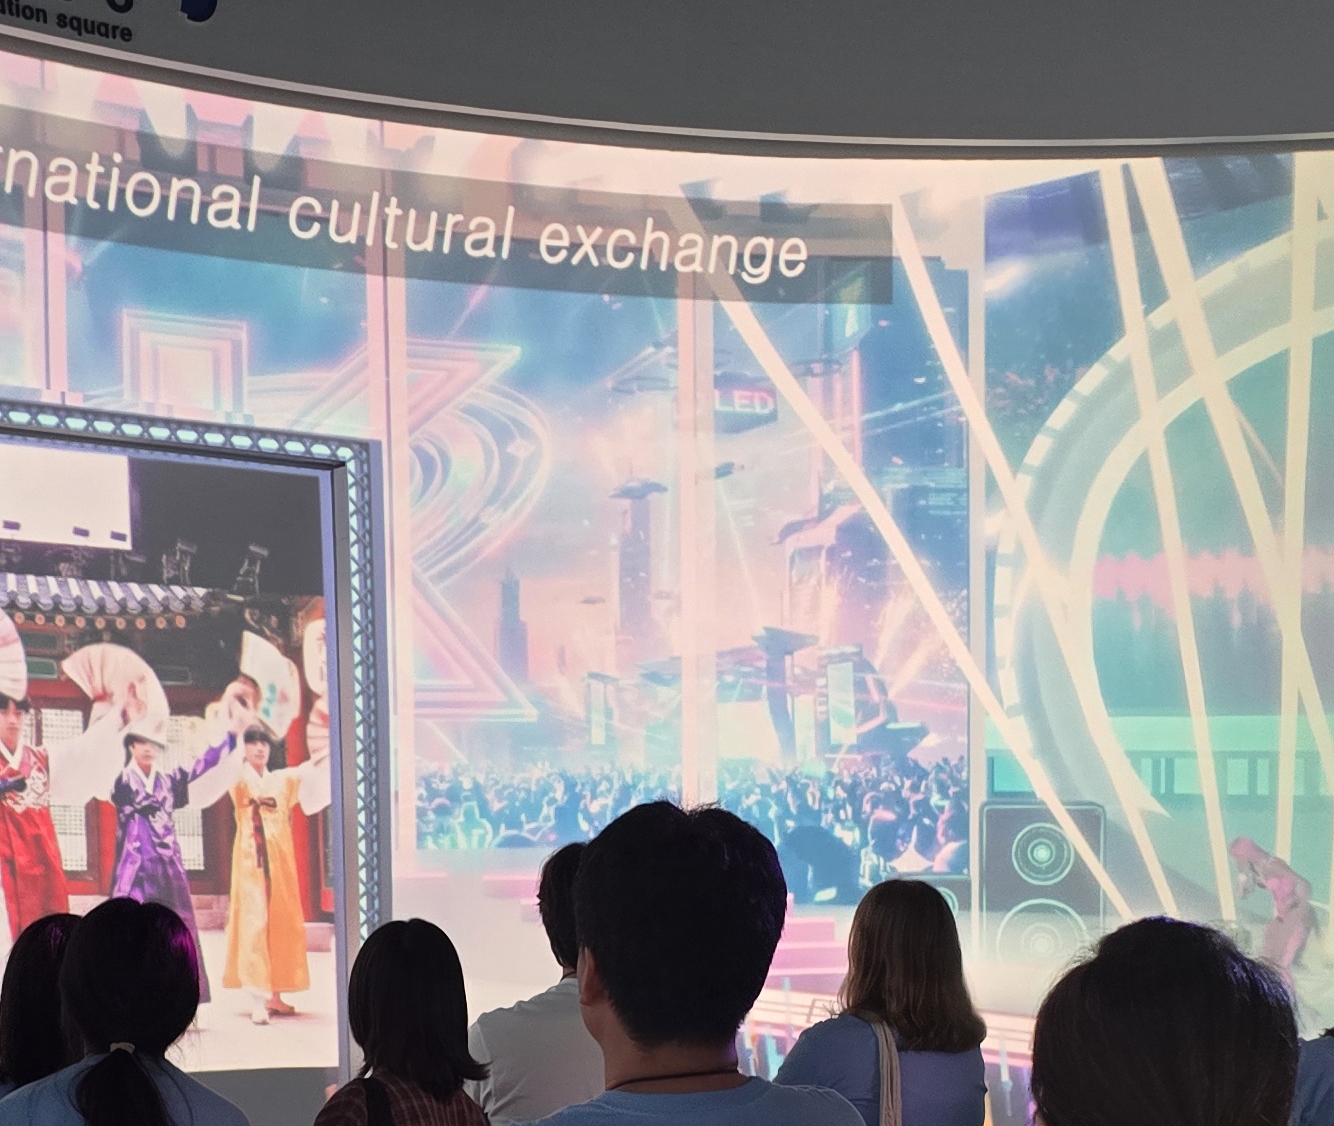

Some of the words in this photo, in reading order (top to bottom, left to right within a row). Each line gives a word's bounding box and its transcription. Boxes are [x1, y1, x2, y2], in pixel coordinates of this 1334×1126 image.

[56, 12, 133, 43] square
[287, 190, 513, 261] cultural
[538, 214, 809, 284] exchange
[714, 388, 774, 414] LED
